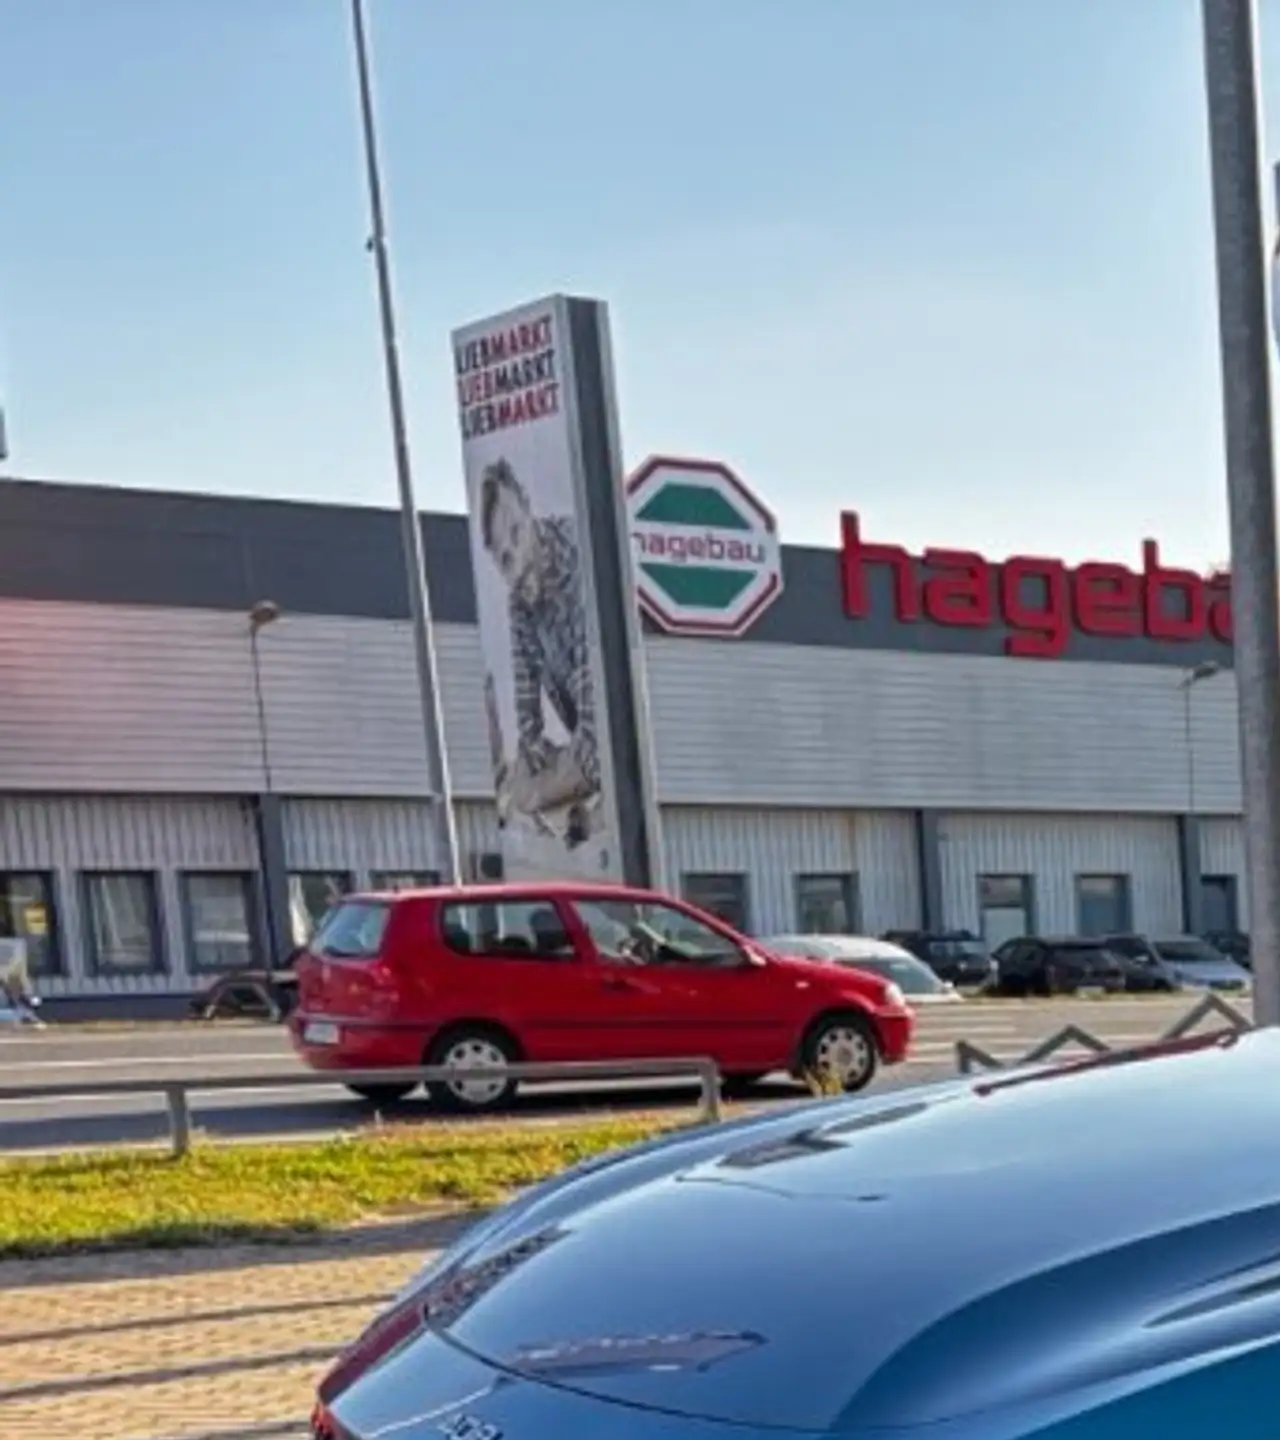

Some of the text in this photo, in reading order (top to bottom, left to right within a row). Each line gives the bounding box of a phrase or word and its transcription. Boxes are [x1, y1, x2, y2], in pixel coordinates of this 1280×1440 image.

[456, 314, 553, 375] LIEBMARKT
[458, 348, 556, 408] LIEBMARKT
[462, 381, 560, 440] LIEBMARKT
